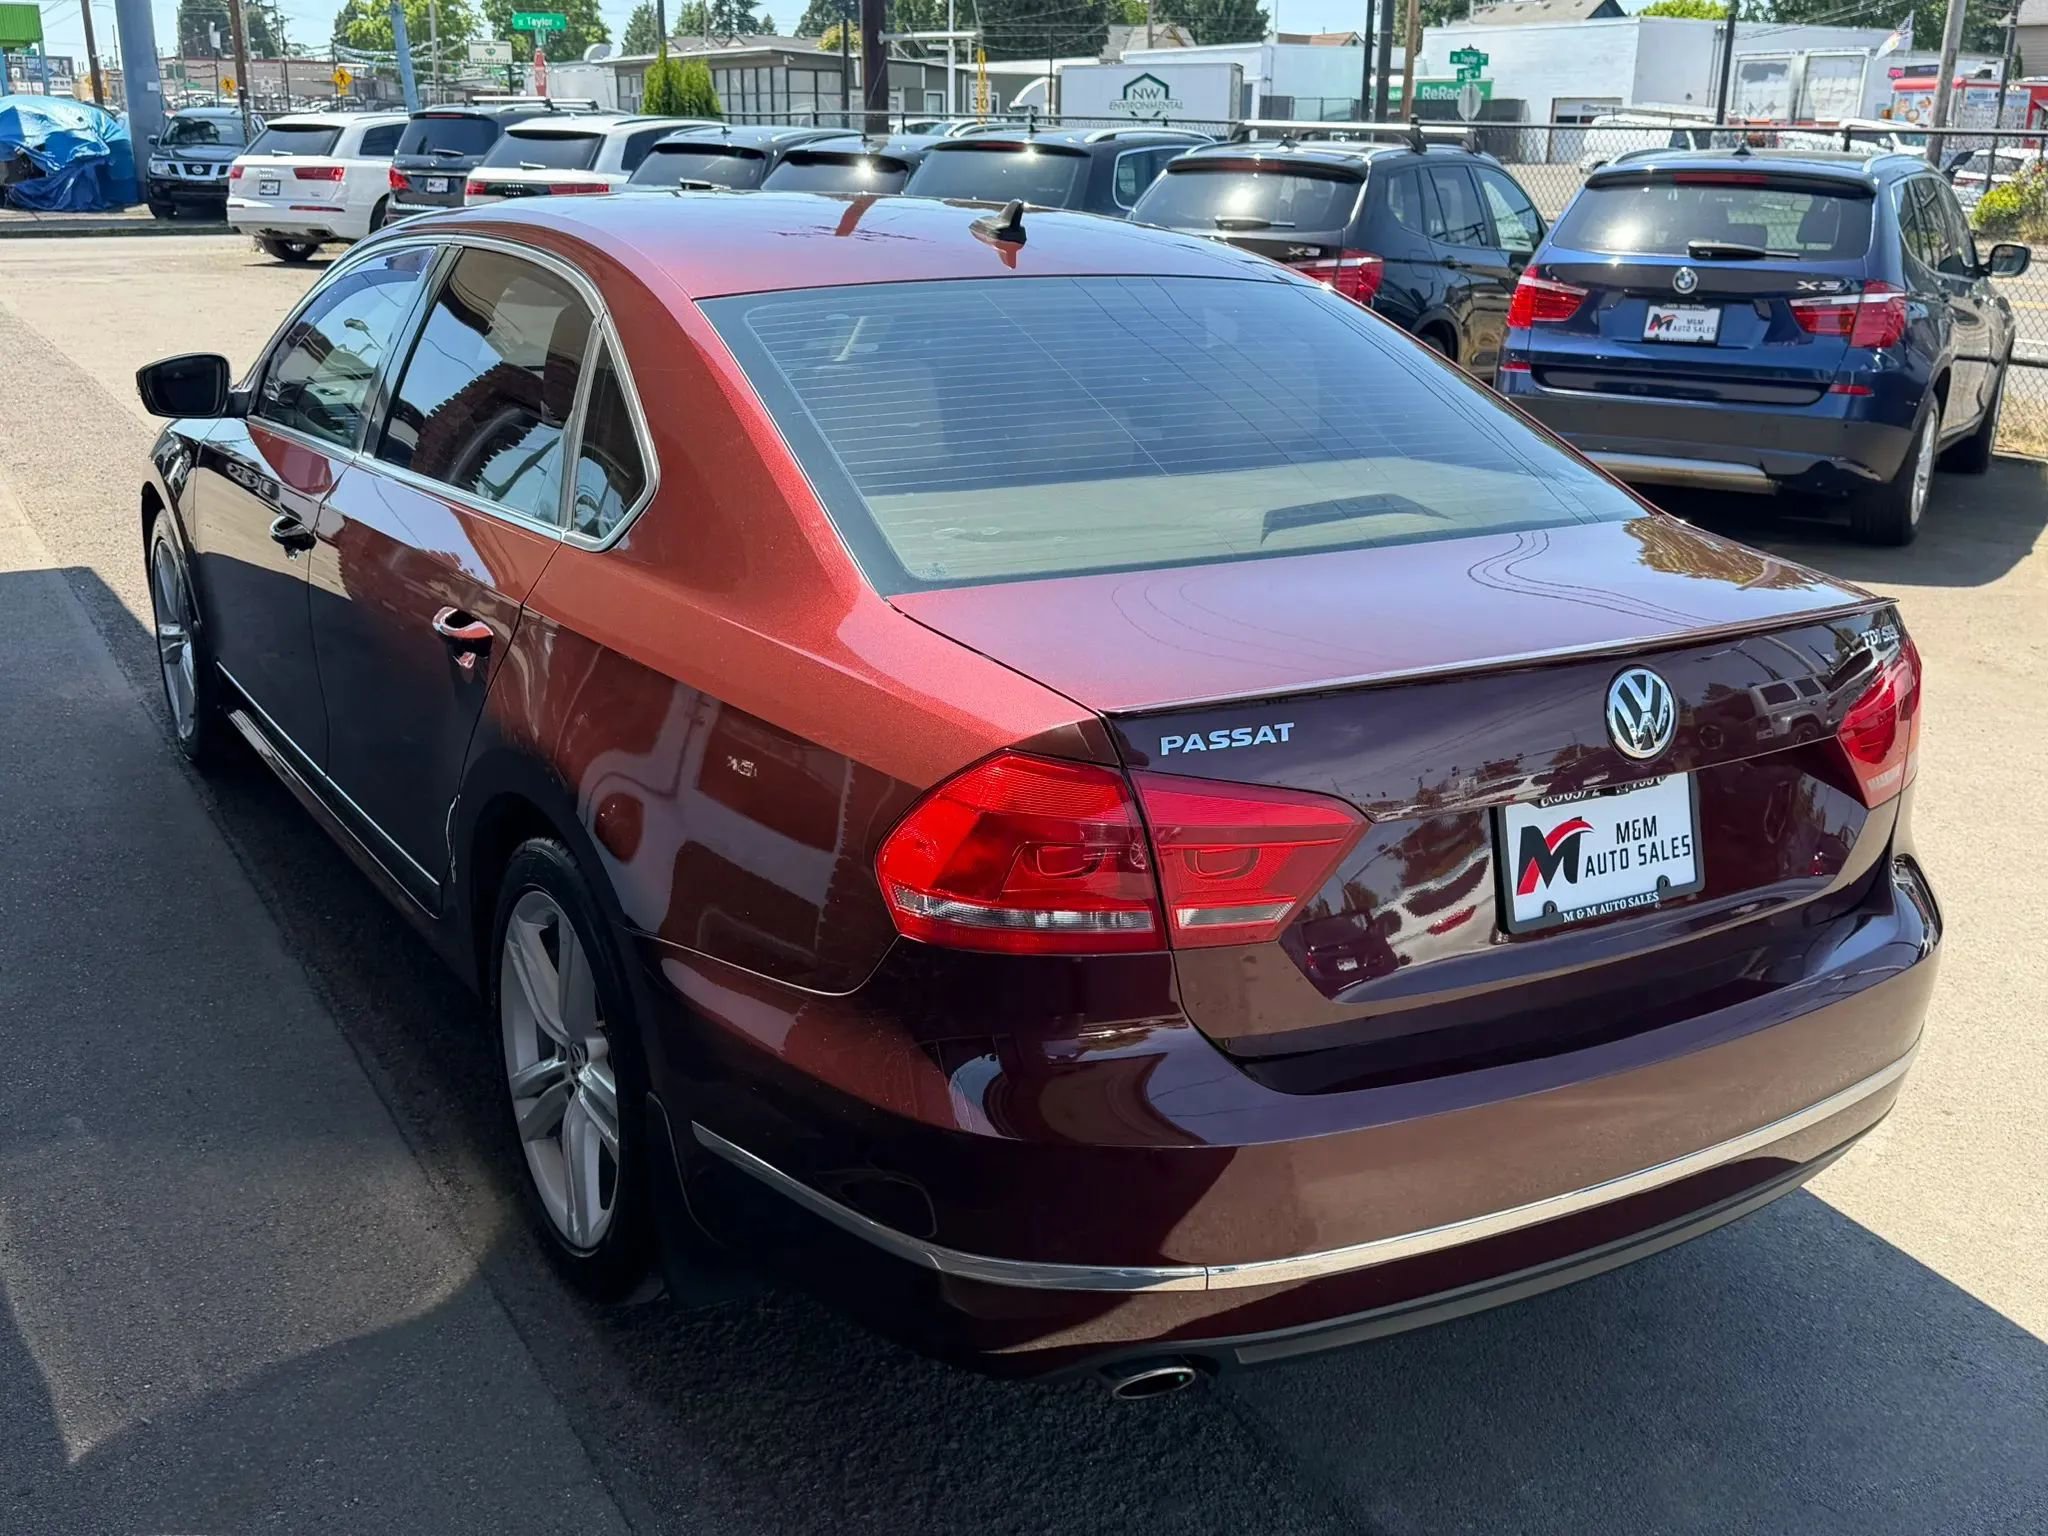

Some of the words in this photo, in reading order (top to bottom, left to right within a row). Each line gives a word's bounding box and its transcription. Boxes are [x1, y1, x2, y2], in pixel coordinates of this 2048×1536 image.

[526, 16, 553, 28] Taylor
[1132, 88, 1160, 100] NW
[1422, 86, 1467, 100] ReRac
[1109, 101, 1184, 111] ENVIRONMENTAL
[1797, 280, 1840, 291] X3
[1673, 325, 1692, 333] AUTO
[1693, 326, 1716, 334] SALES
[1160, 722, 1295, 756] PASSAT
[1616, 815, 1658, 844] M&M
[1585, 849, 1629, 878] AUTO
[1638, 835, 1691, 866] SALES
[1563, 912, 1575, 923] M
[1576, 910, 1586, 920] &
[1586, 908, 1598, 918] M
[1599, 901, 1627, 915] AUTO
[1628, 892, 1660, 908] SALES
